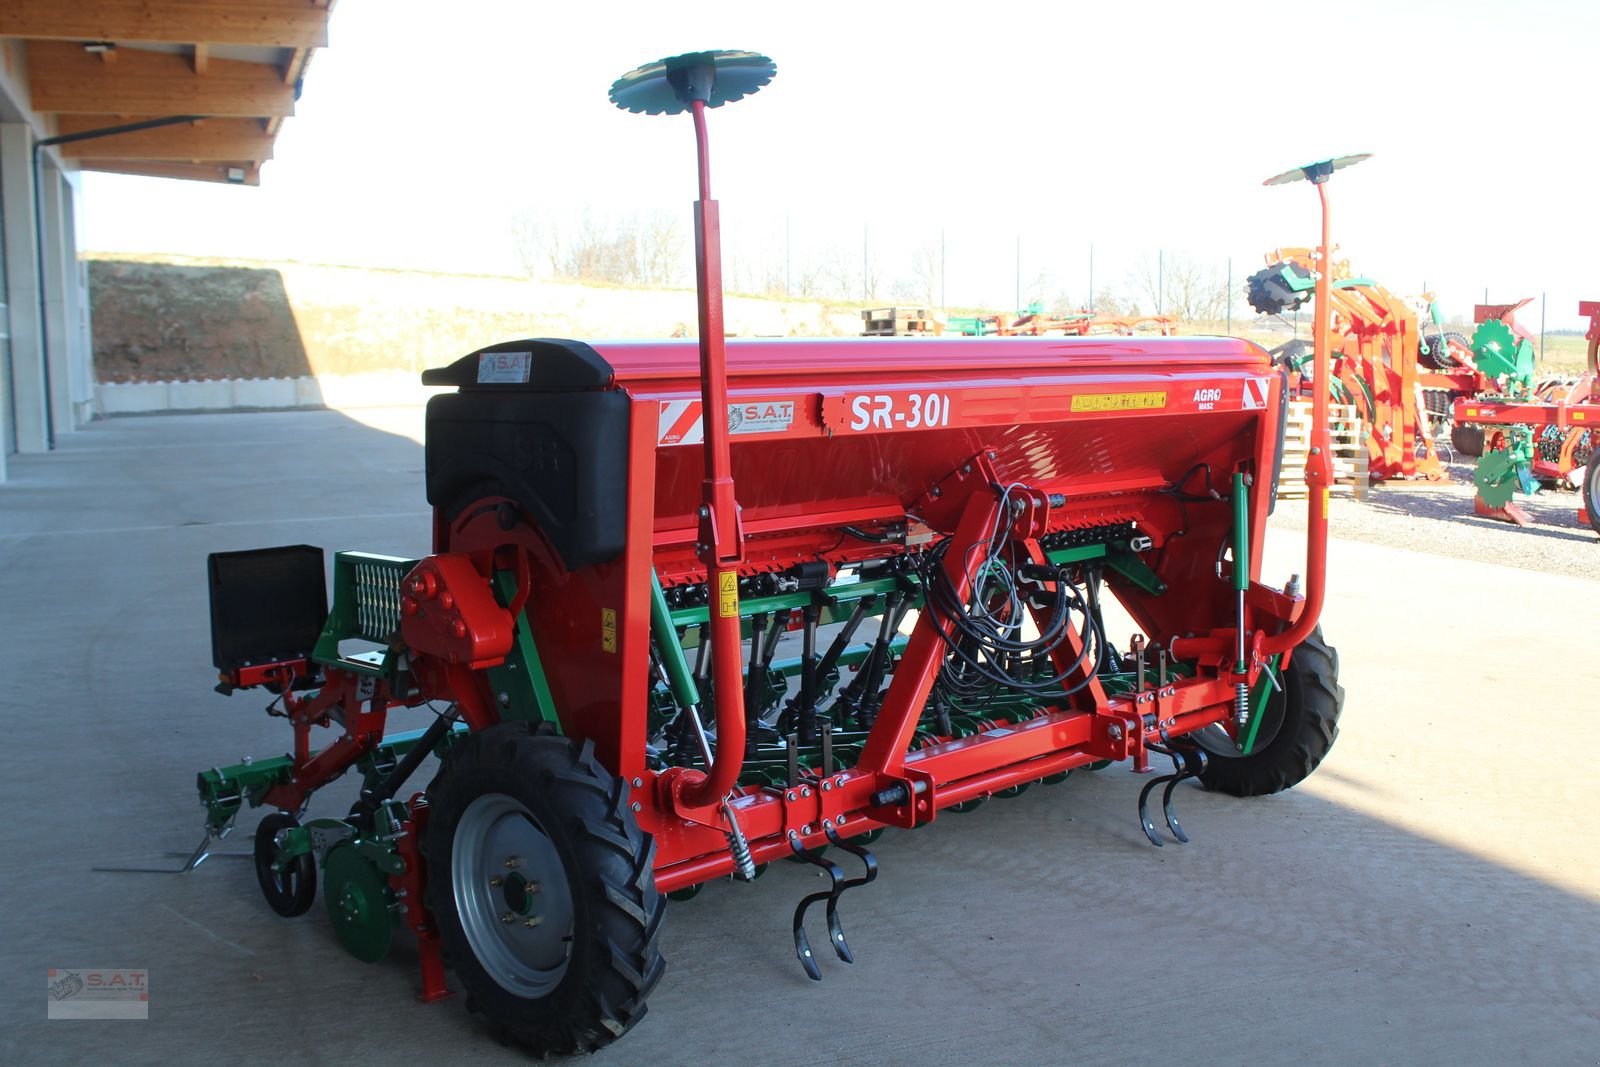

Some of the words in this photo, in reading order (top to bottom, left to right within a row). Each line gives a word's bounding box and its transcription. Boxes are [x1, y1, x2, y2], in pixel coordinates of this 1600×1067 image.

[1193, 388, 1221, 402] AGRO
[745, 404, 792, 420] S.A.T.
[850, 393, 950, 431] SR-301
